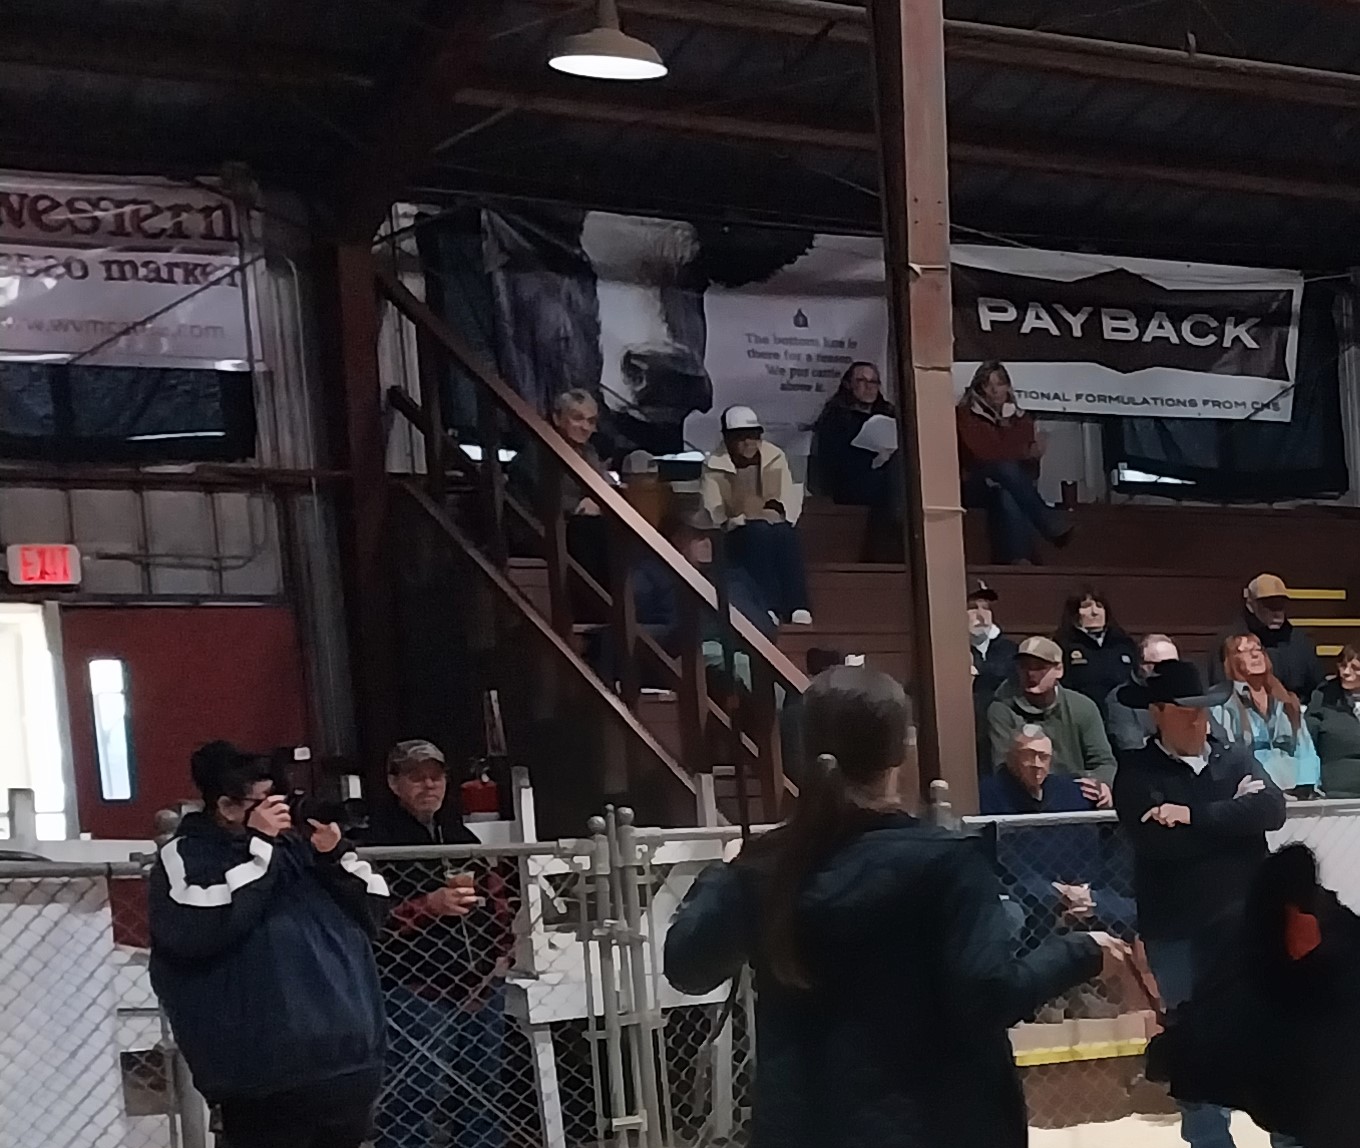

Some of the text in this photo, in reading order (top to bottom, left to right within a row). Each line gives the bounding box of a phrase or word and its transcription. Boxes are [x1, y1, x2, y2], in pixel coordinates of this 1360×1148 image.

[977, 297, 1261, 349] PAYBACK
[1014, 388, 1071, 403] TIONAL
[1074, 391, 1199, 409] FORMULATIONS
[1202, 397, 1248, 411] FROM
[20, 545, 70, 582] EXIT
